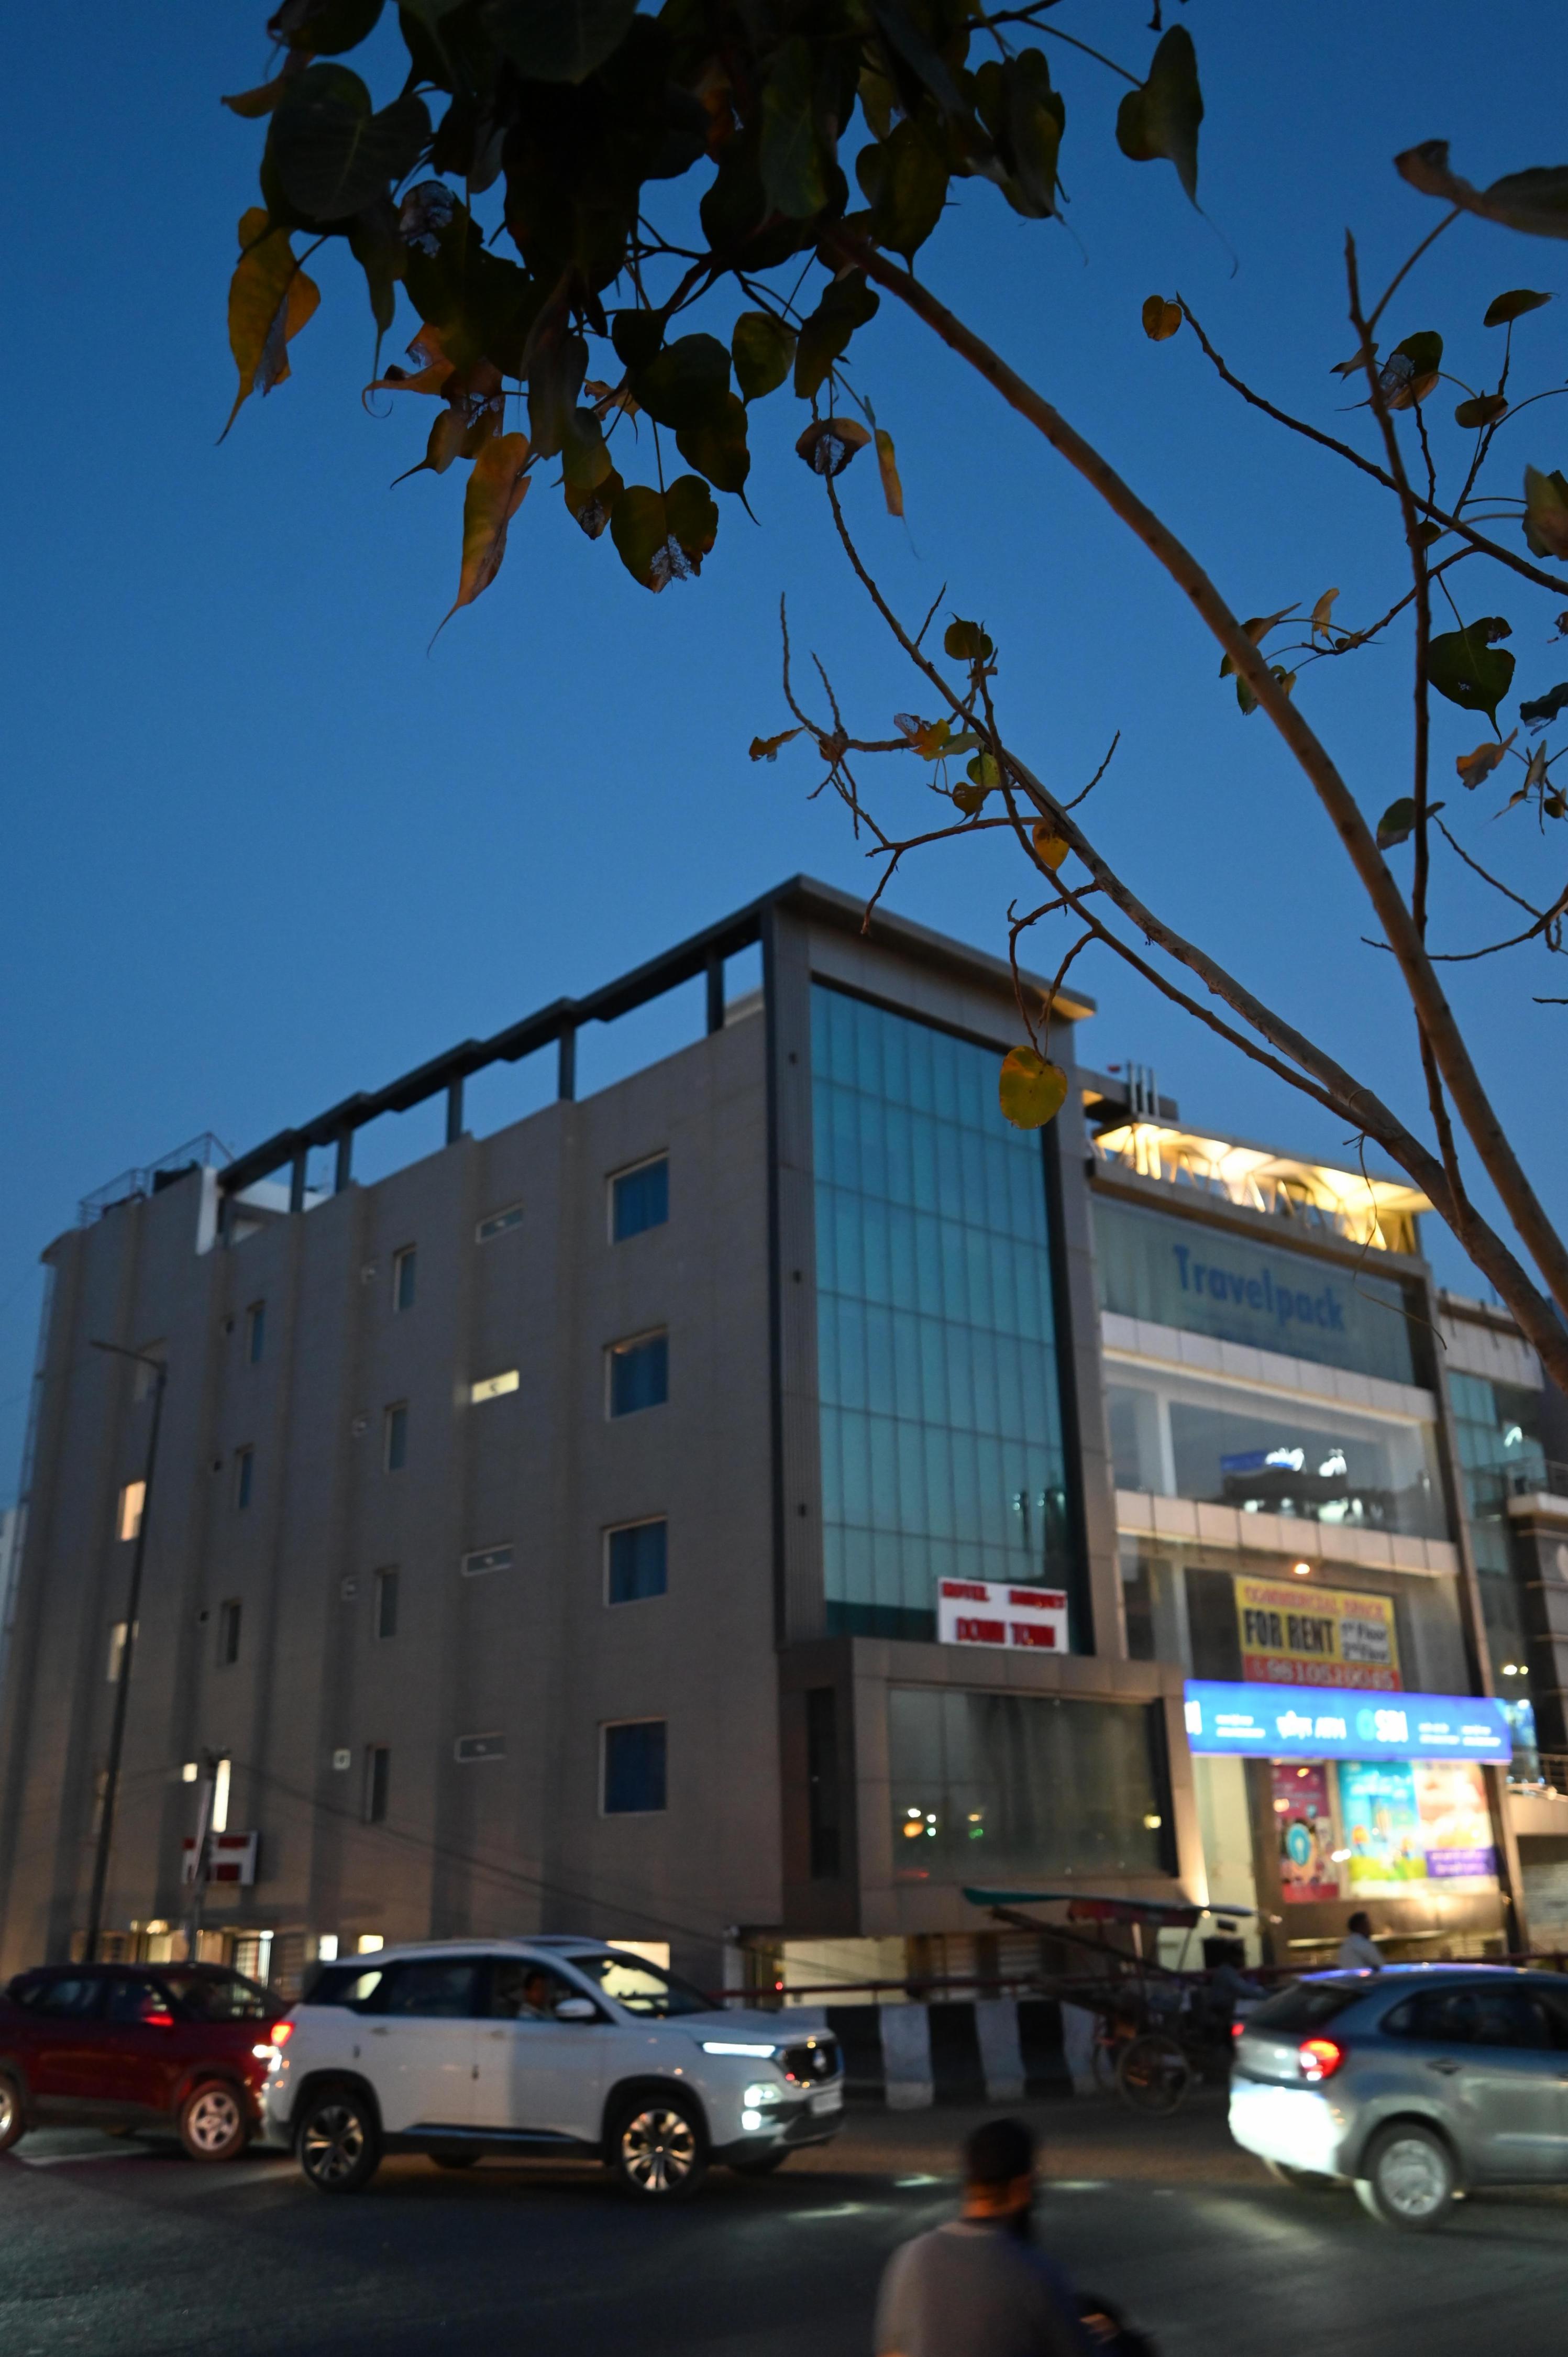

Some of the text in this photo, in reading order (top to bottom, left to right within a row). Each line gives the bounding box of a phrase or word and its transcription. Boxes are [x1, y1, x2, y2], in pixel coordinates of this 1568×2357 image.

[1173, 1244, 1344, 1329] Travelpack
[1243, 1609, 1334, 1654] FOR RENT
[1374, 1709, 1408, 1743] SBI
